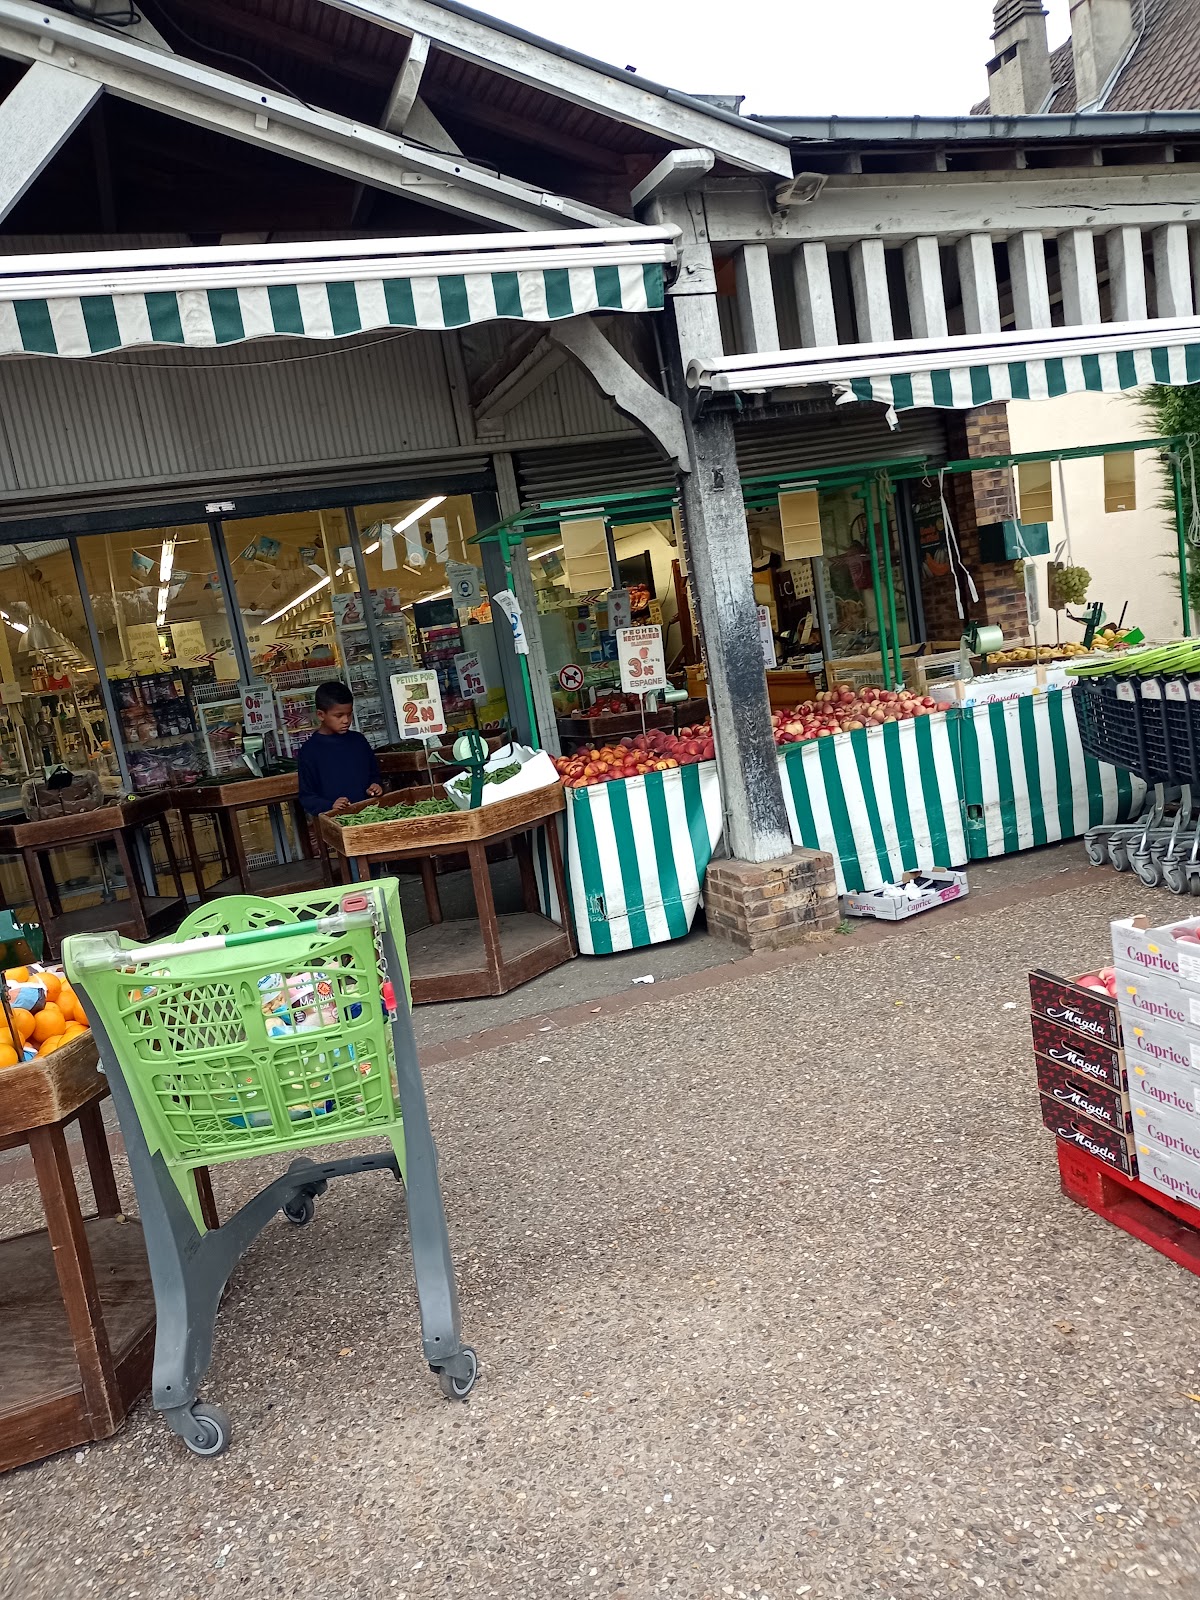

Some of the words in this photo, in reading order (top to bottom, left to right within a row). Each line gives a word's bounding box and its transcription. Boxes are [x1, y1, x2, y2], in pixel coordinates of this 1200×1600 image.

[623, 632, 660, 643] NECTARINES
[395, 674, 419, 685] PETITS
[420, 672, 435, 682] POIS
[629, 677, 663, 688] ESPAGNE
[907, 898, 932, 912] Caprice
[1127, 945, 1180, 973] Caprice
[1046, 1007, 1105, 1035] Magda
[1132, 993, 1185, 1022] Caprice
[1049, 1048, 1108, 1079] Magda
[1137, 1036, 1190, 1067] Caprice
[1053, 1088, 1112, 1121] Magda
[1141, 1079, 1194, 1113] Caprice
[1057, 1127, 1116, 1162] Magda
